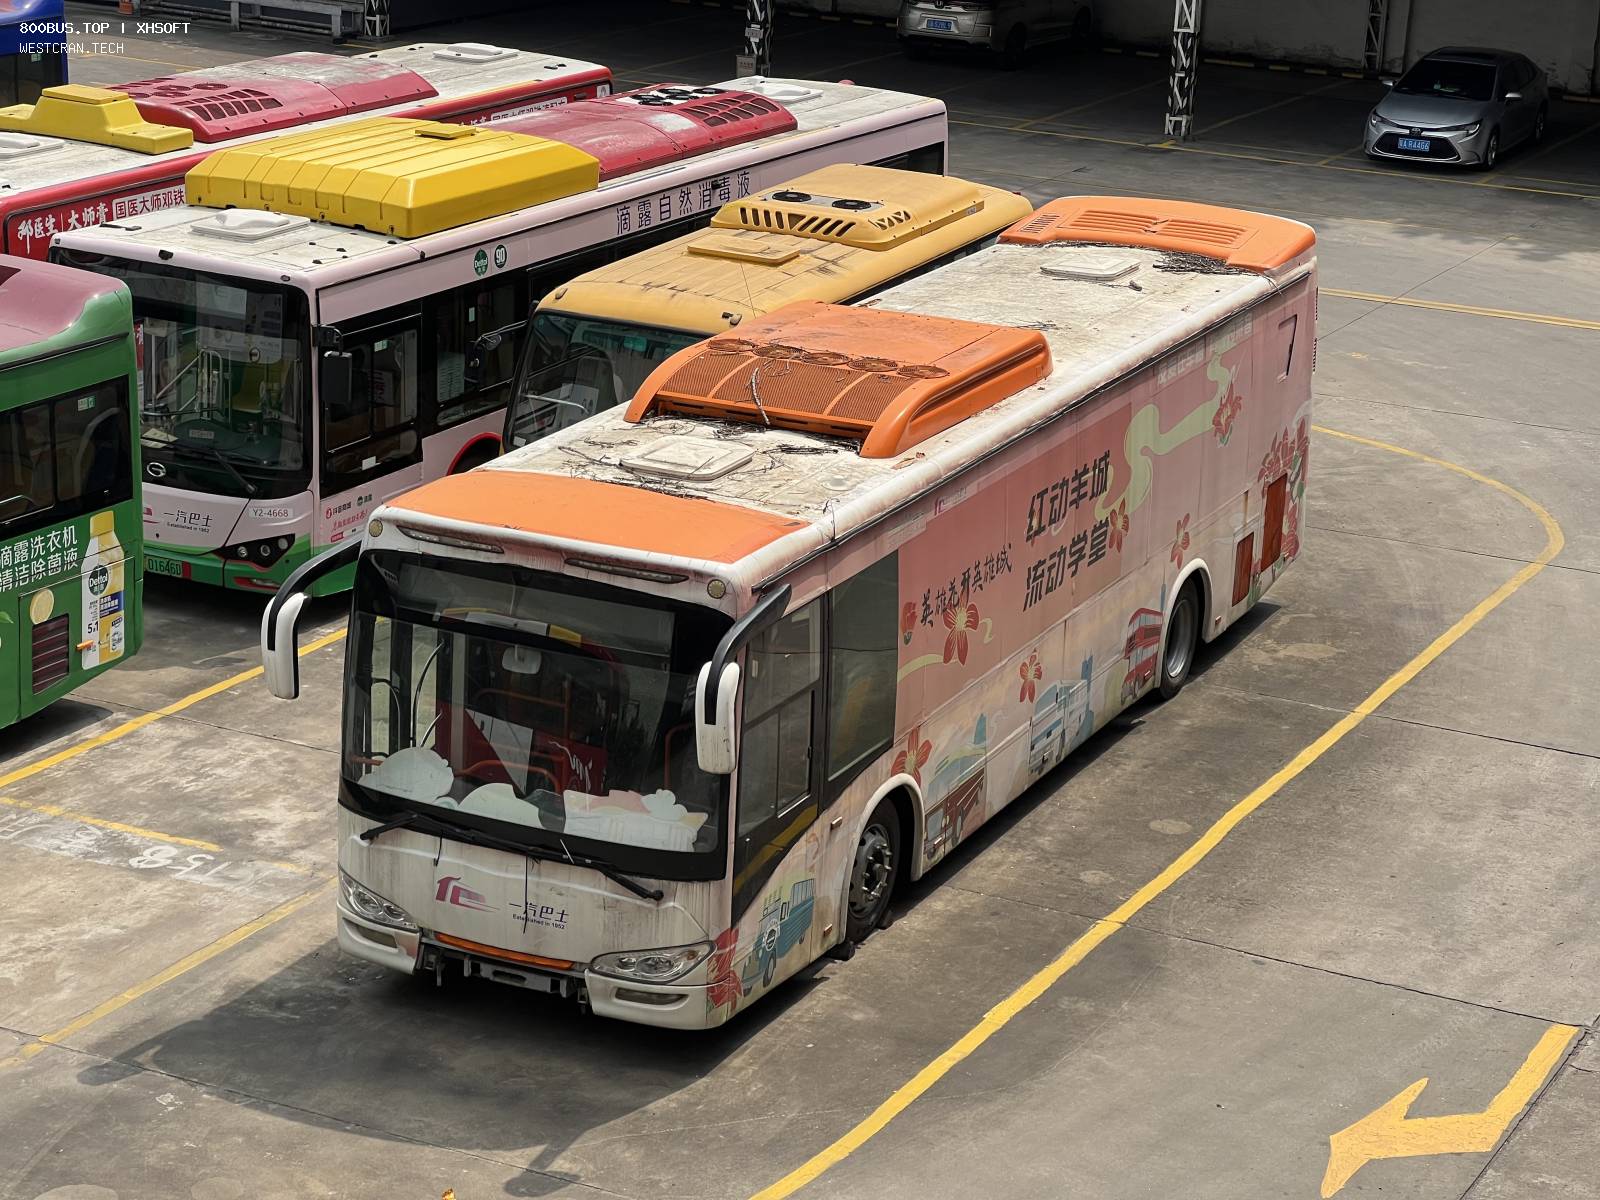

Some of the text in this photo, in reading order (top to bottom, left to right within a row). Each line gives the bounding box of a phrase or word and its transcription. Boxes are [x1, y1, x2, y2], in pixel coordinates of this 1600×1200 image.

[114, 188, 186, 219] 国医大师邓铁
[615, 170, 751, 236] 滴露自然消毒液
[495, 246, 506, 264] 90
[1025, 450, 1111, 543] 红动羊城
[163, 509, 213, 527] 一汽巴士
[252, 508, 289, 518] Y2-4668
[0, 547, 78, 593] 清洁除菌液
[1023, 516, 1110, 612] 流动学堂
[89, 572, 108, 588] Dettol
[508, 901, 569, 924] 一汽巴士
[512, 913, 544, 926] Estalished
